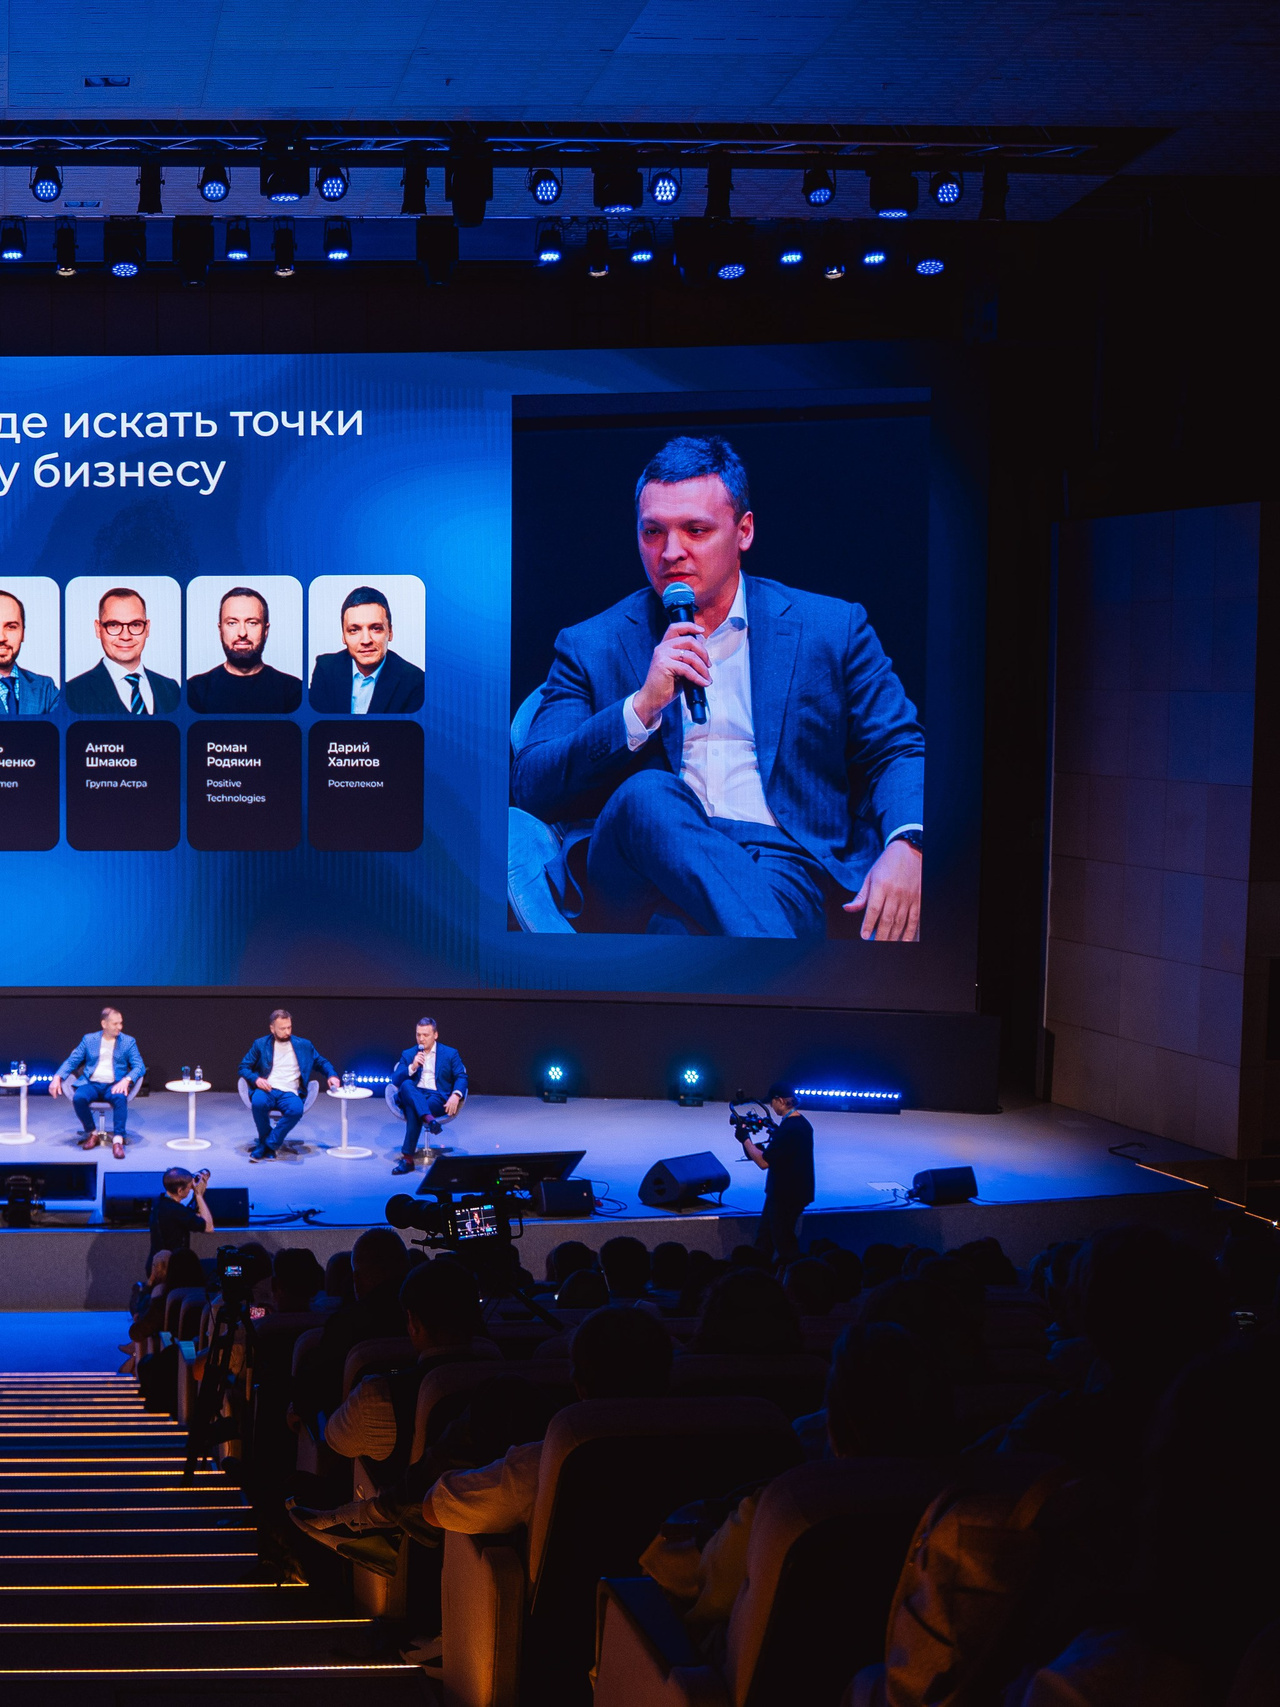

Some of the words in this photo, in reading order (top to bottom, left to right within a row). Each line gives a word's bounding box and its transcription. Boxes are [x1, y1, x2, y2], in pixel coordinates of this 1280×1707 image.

[64, 411, 218, 438] искать
[230, 409, 363, 436] точки
[34, 452, 226, 495] бизнесу
[85, 742, 125, 753] Антон
[206, 742, 248, 753] Роман
[327, 741, 370, 754] Дарий
[86, 757, 137, 767] Шмаков
[206, 756, 262, 768] Родякин
[328, 757, 379, 767] Халитов
[86, 779, 118, 790] Группа
[119, 779, 148, 789] Астра
[206, 778, 242, 788] Positive
[328, 779, 384, 788] Ростелеком
[206, 793, 267, 804] Technologies
